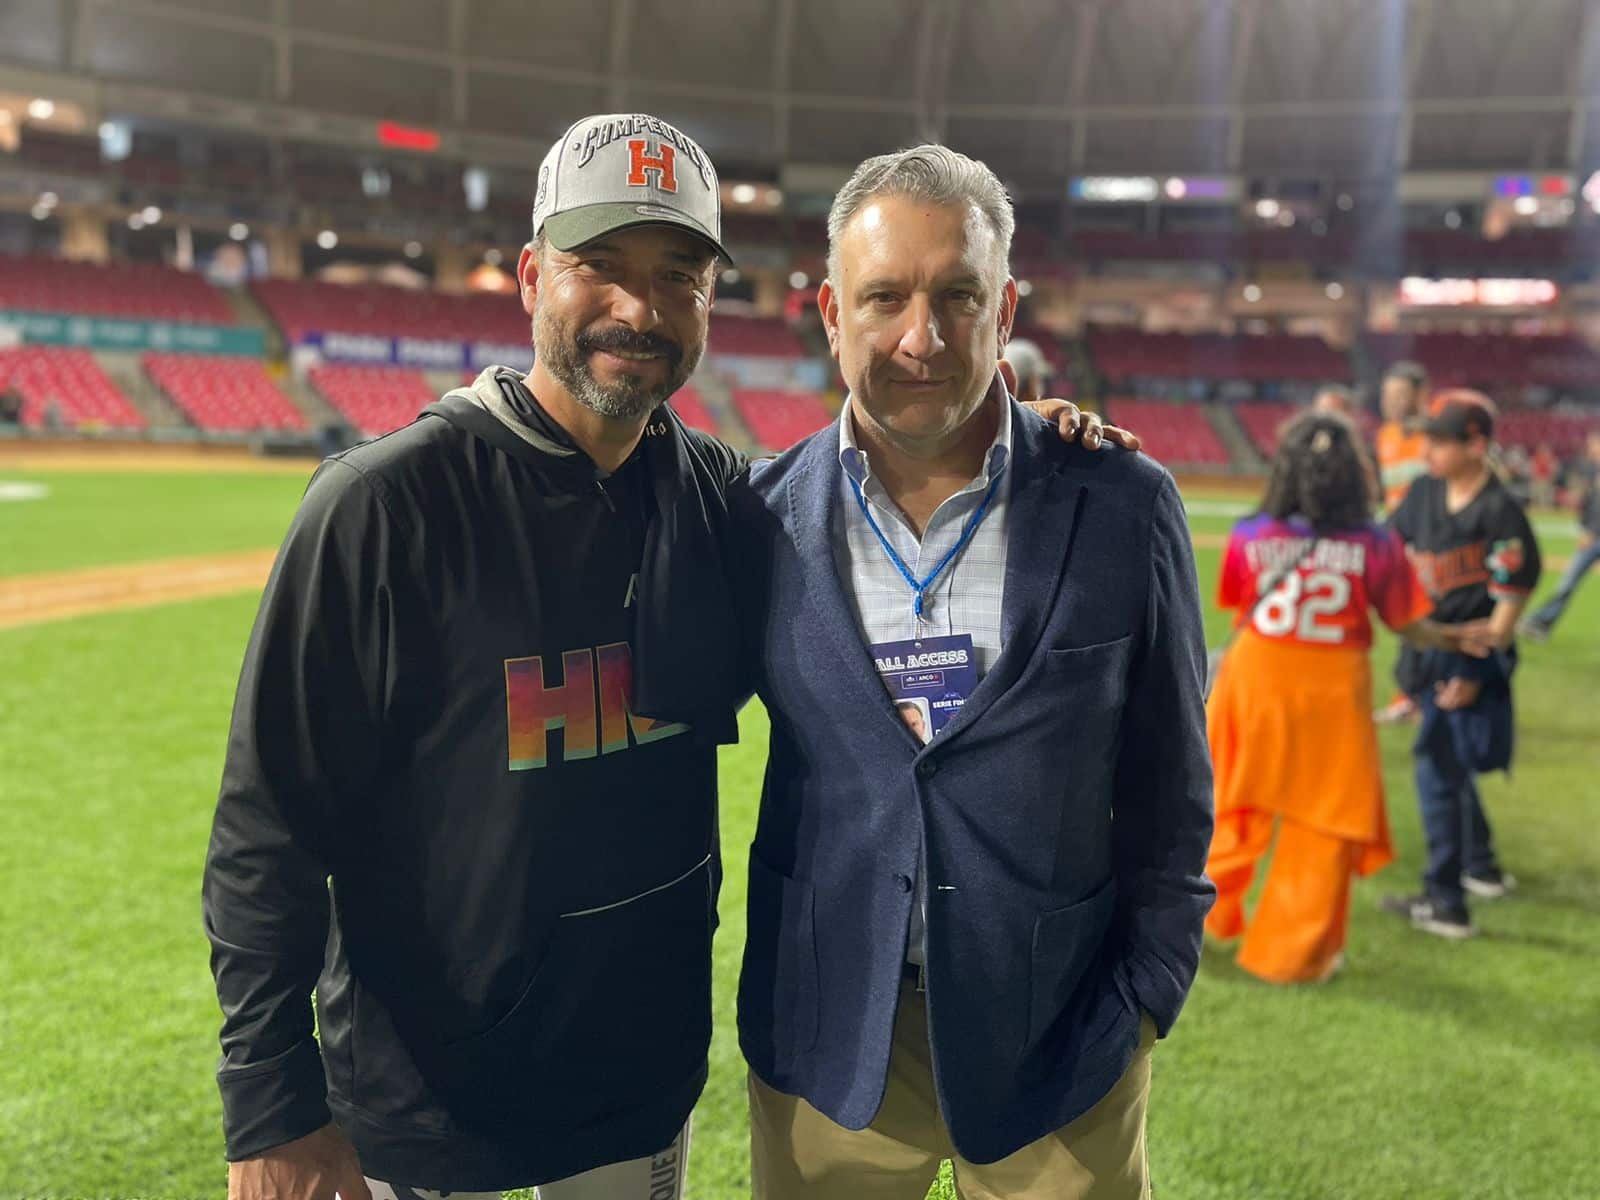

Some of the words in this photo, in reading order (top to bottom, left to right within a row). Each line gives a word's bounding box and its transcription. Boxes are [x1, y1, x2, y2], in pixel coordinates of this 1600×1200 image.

[626, 138, 678, 193] H
[1253, 570, 1351, 644] 82
[875, 656, 905, 672] ALL
[907, 650, 968, 668] ACCESS
